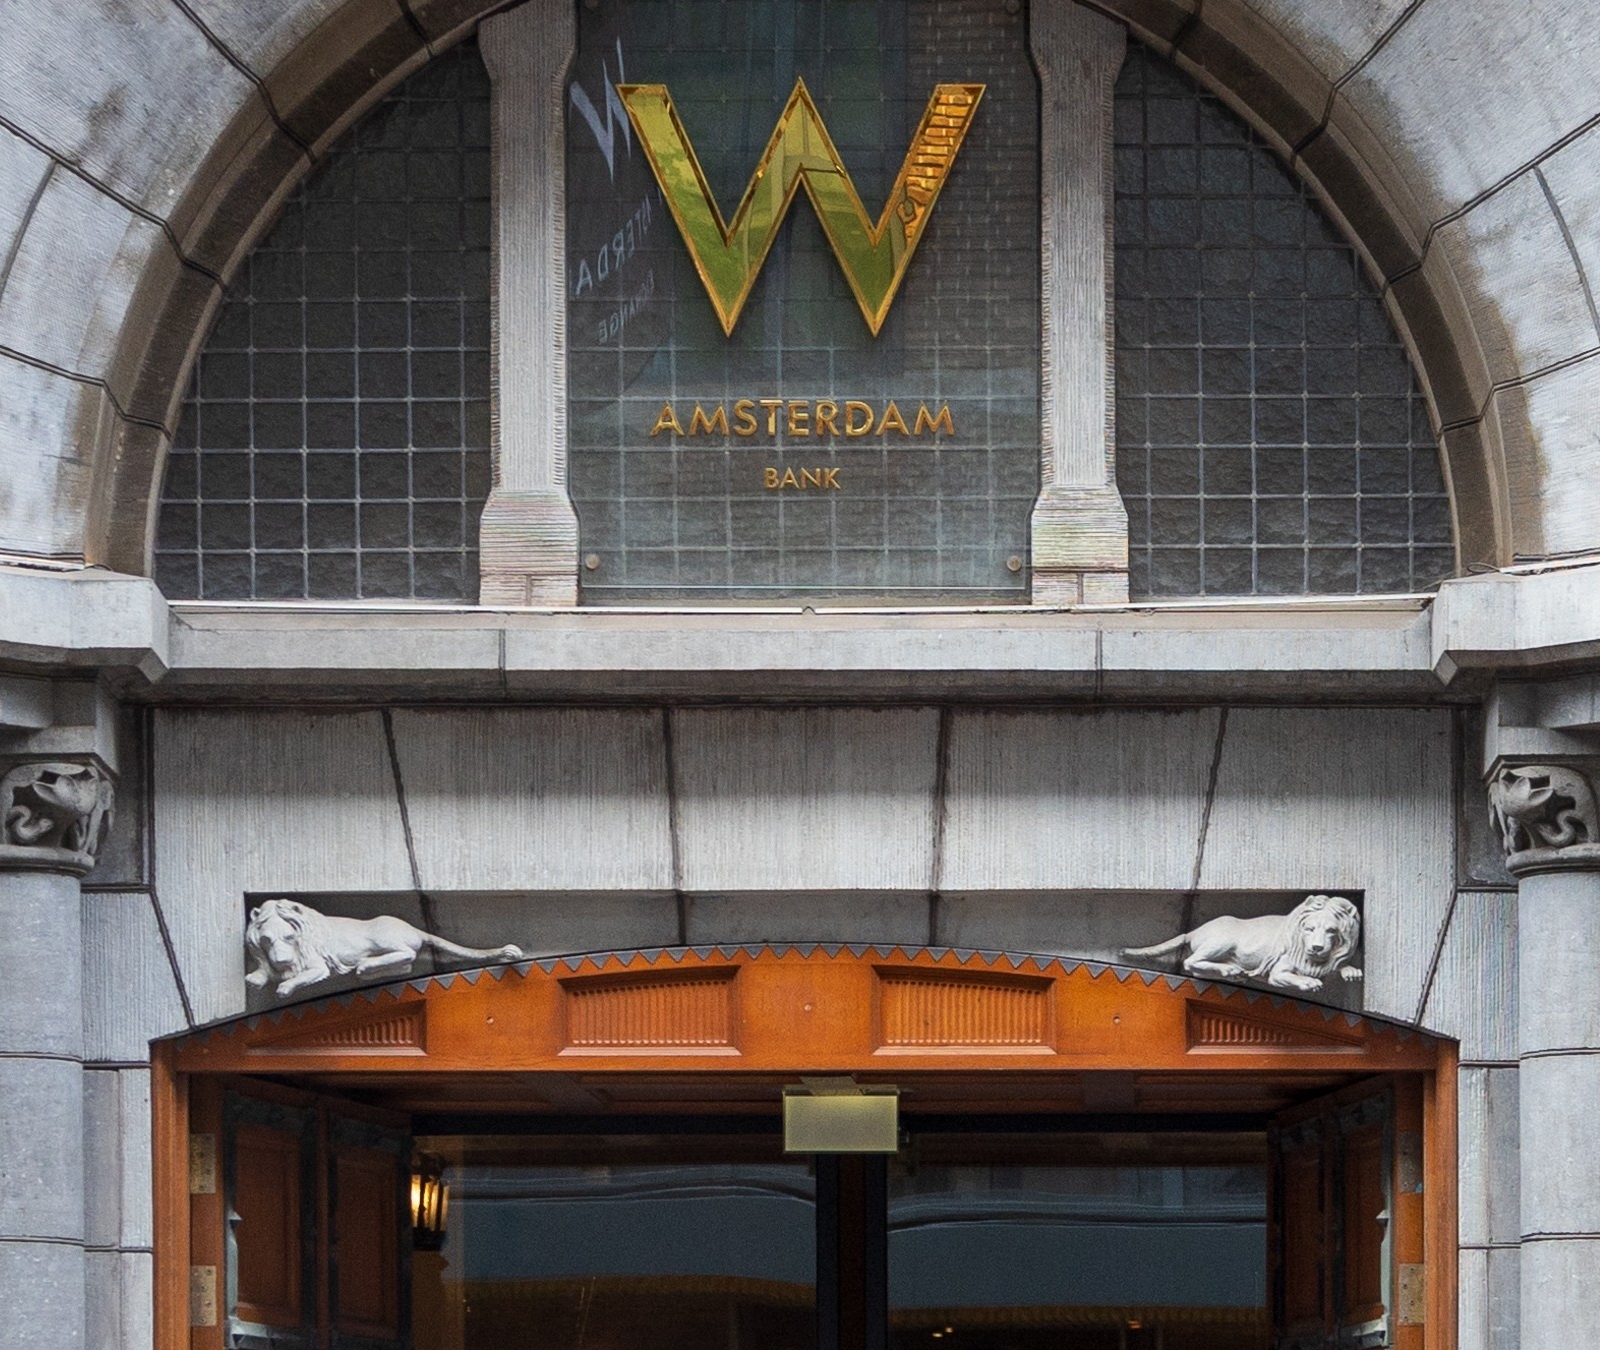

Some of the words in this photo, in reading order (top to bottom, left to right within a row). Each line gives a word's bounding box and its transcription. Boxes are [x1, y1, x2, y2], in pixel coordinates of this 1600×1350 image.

[615, 76, 987, 338] W
[650, 398, 956, 438] AMSTERDAM
[764, 467, 842, 490] BANK
